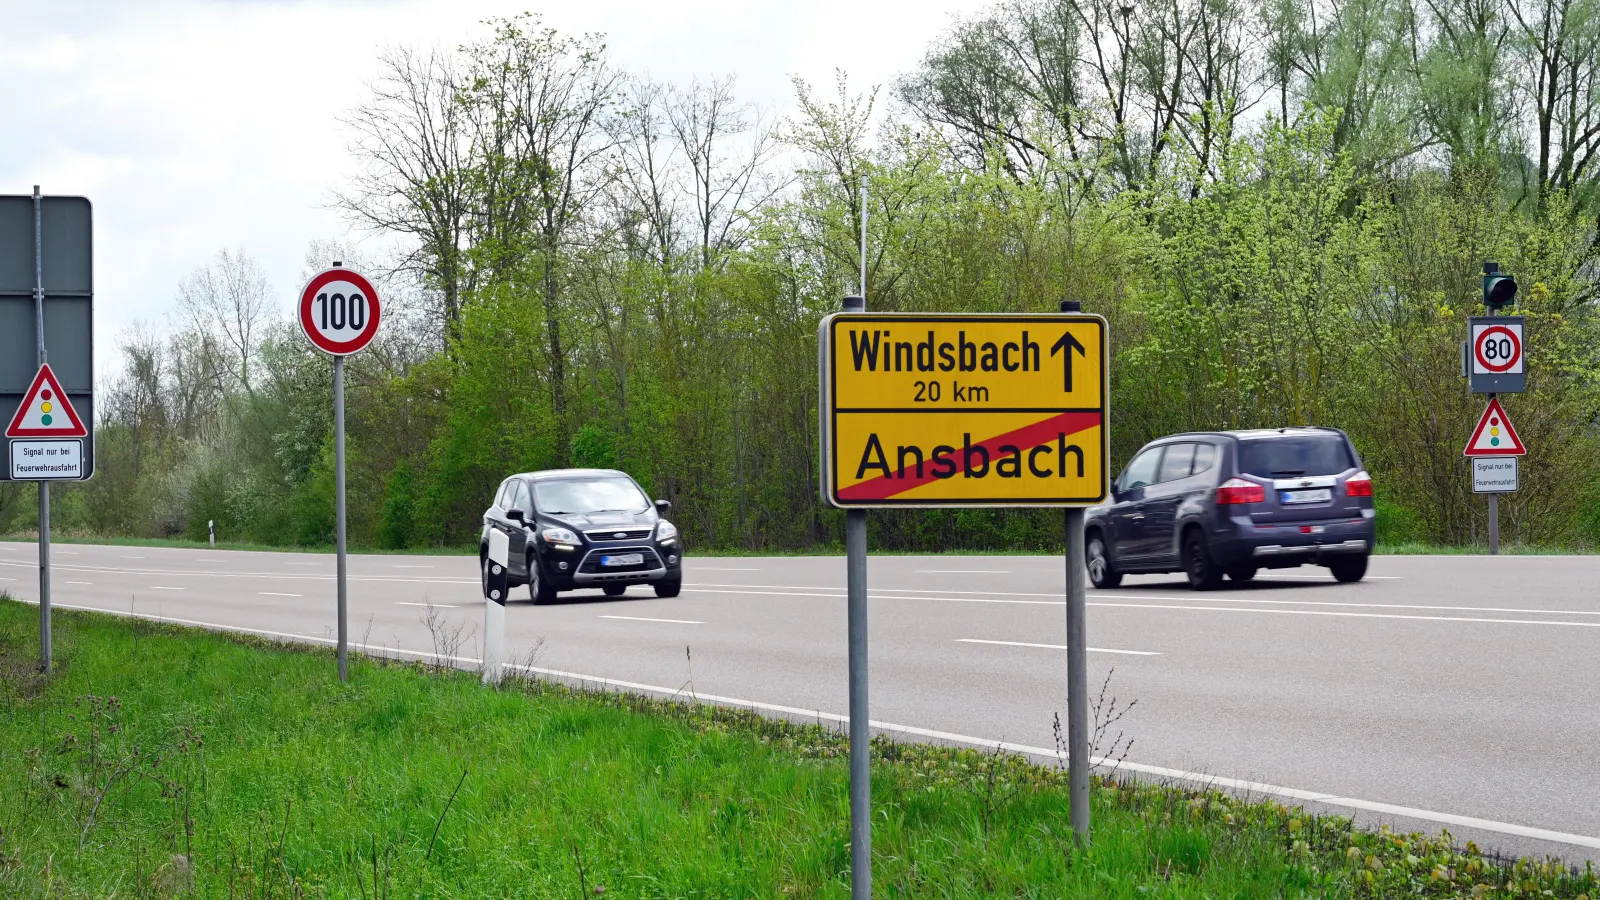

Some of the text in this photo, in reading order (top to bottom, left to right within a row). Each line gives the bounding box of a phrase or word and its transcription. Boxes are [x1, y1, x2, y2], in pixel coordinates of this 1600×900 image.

[317, 293, 364, 330] 100
[849, 330, 1040, 372] Windsbach
[1485, 339, 1511, 359] 80
[913, 380, 989, 402] 20 km
[24, 448, 44, 457] Signal
[60, 447, 70, 455] bei
[855, 432, 1084, 479] Ansbach
[16, 463, 77, 472] Feuerwehrausfahrt
[1477, 463, 1494, 471] Signal
